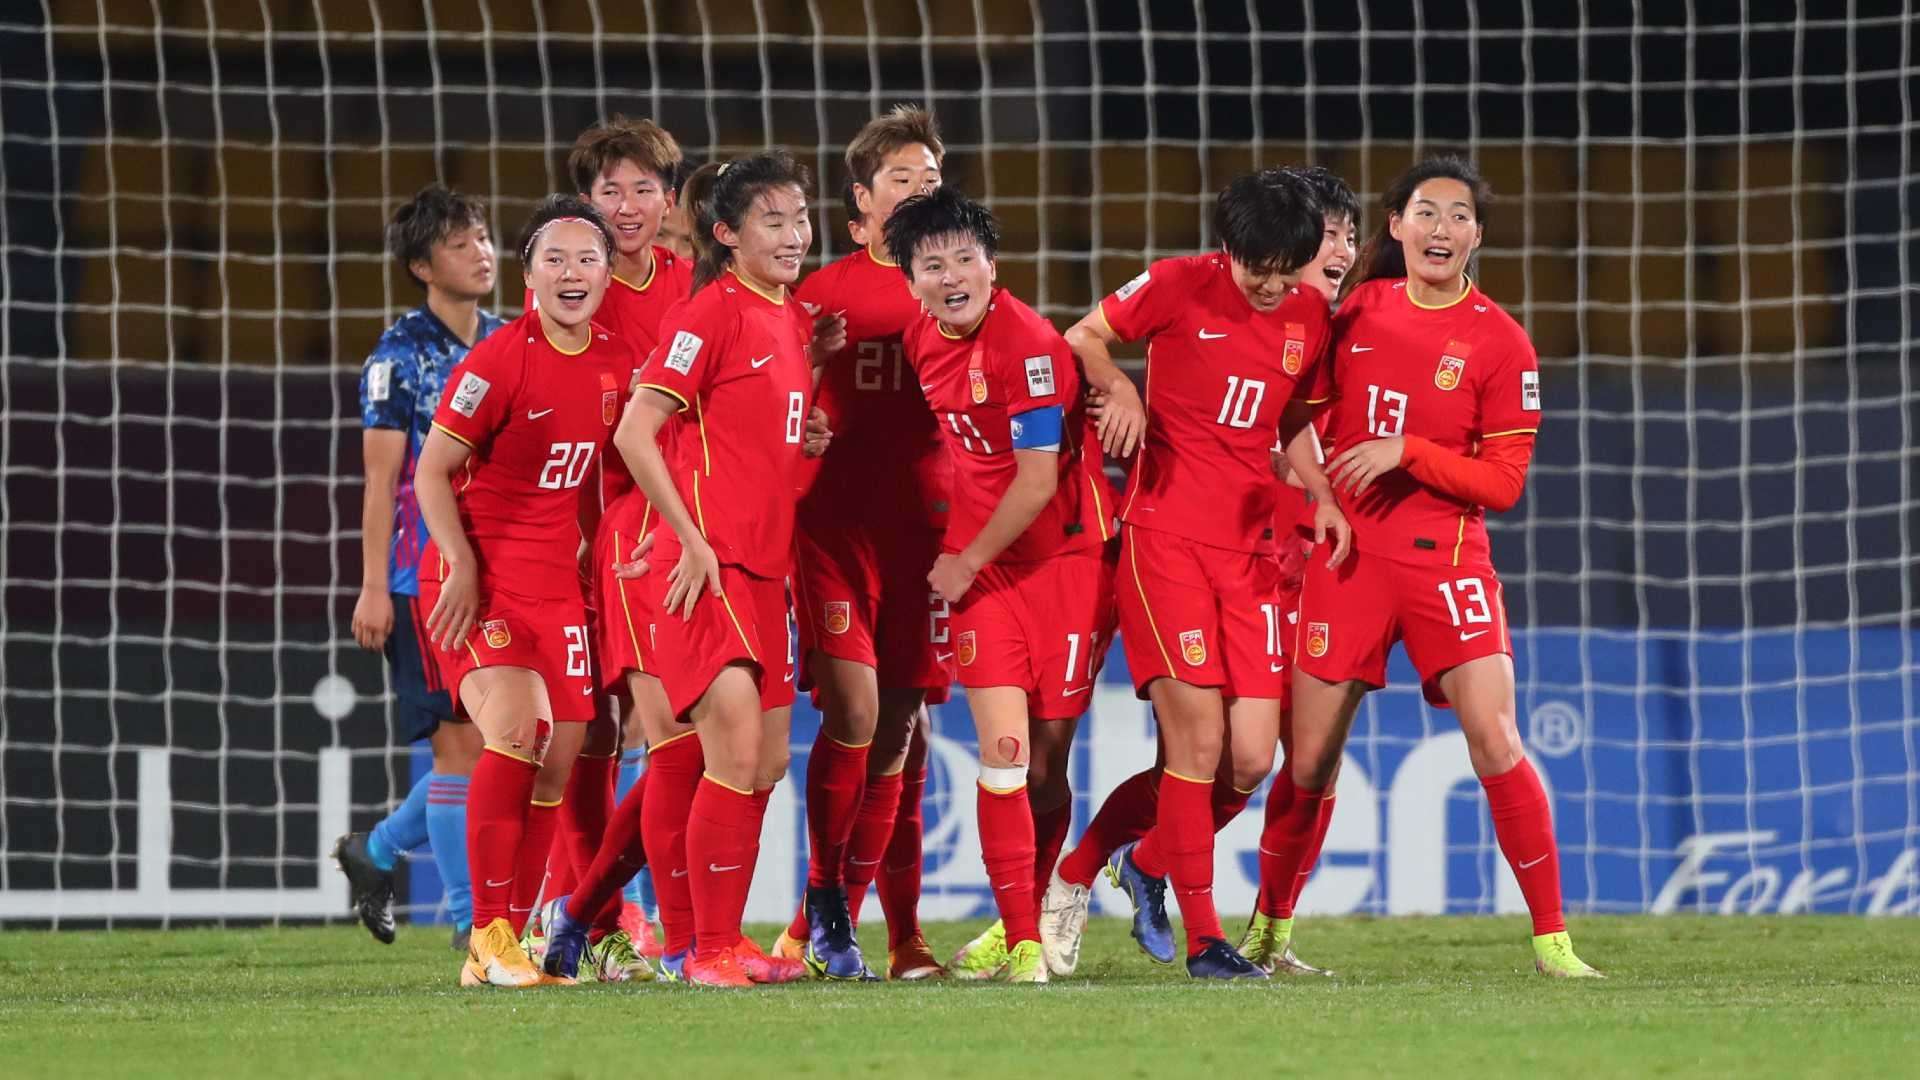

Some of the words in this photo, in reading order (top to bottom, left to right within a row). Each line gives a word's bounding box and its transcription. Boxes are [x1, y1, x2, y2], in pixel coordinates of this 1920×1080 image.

[856, 342, 902, 391] 21
[786, 391, 803, 444] 8
[1217, 375, 1265, 429] 10
[1367, 384, 1408, 437] 13
[947, 412, 993, 455] 11
[538, 441, 596, 490] 20
[1438, 577, 1492, 628] 13
[1650, 829, 1851, 916] For
